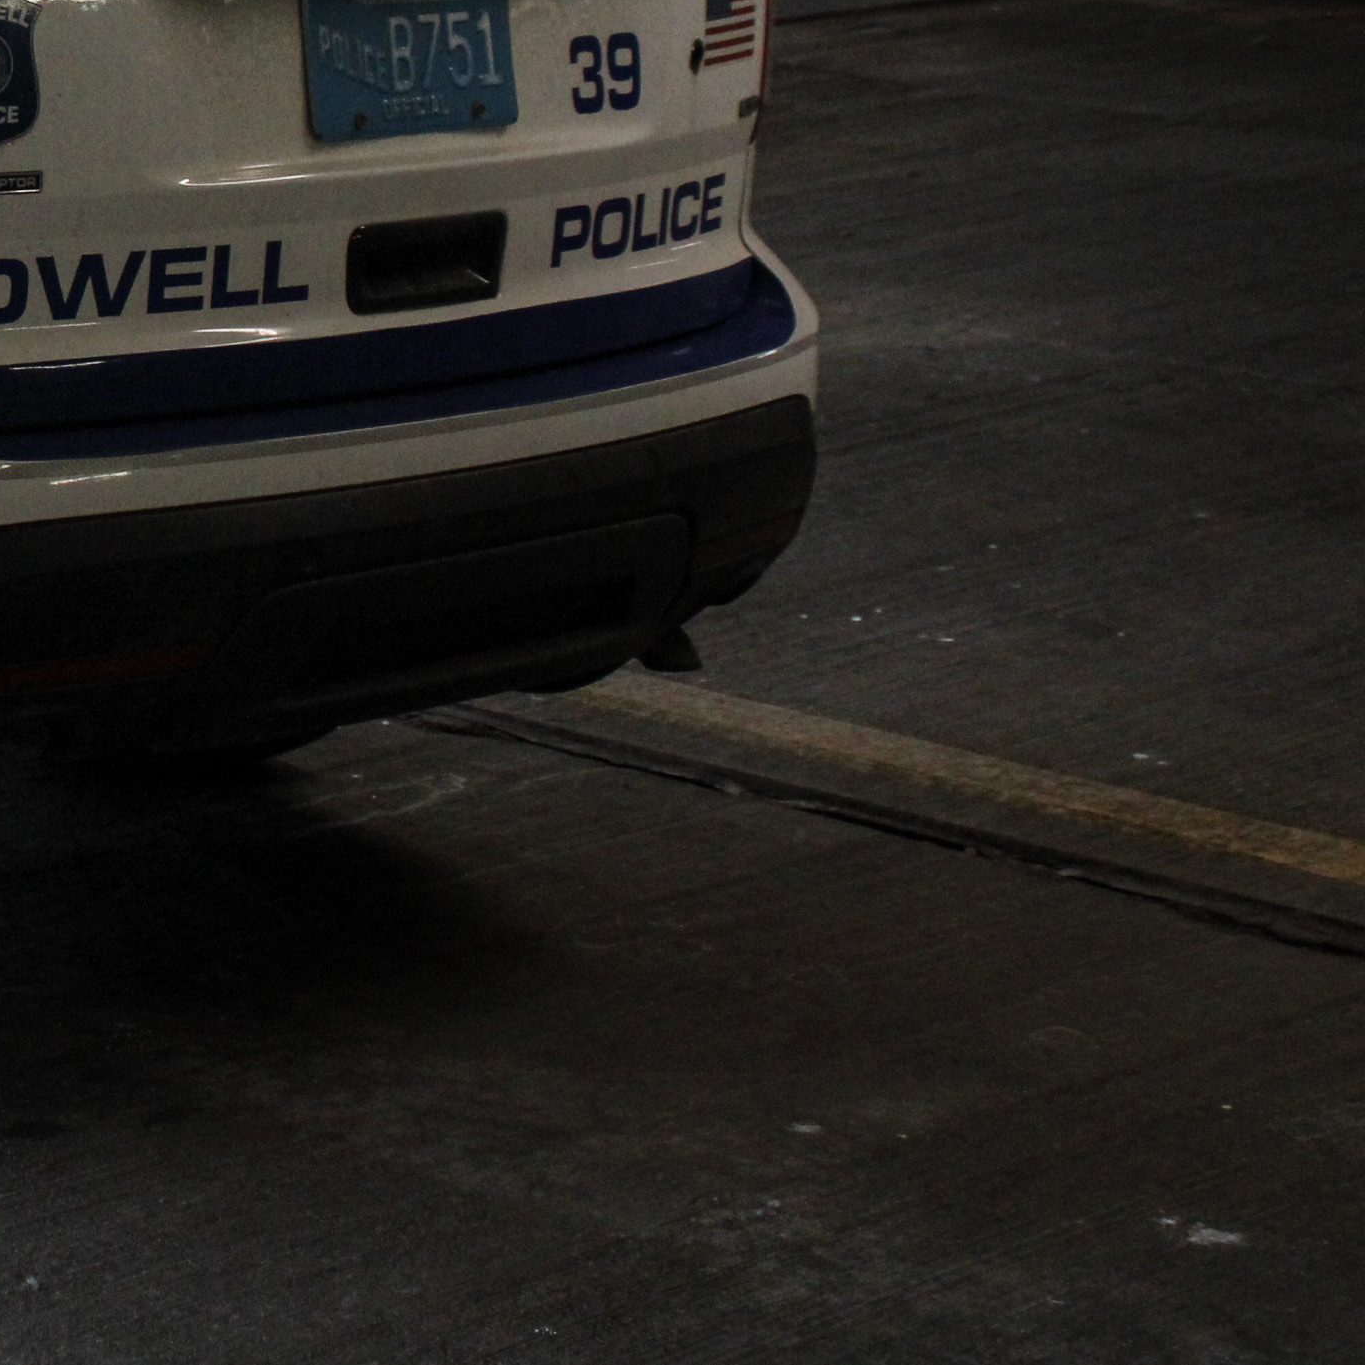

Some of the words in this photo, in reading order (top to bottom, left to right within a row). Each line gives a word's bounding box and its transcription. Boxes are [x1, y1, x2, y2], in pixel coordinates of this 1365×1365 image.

[388, 10, 503, 92] B751
[569, 33, 640, 114] 39
[551, 173, 725, 267] POLICE
